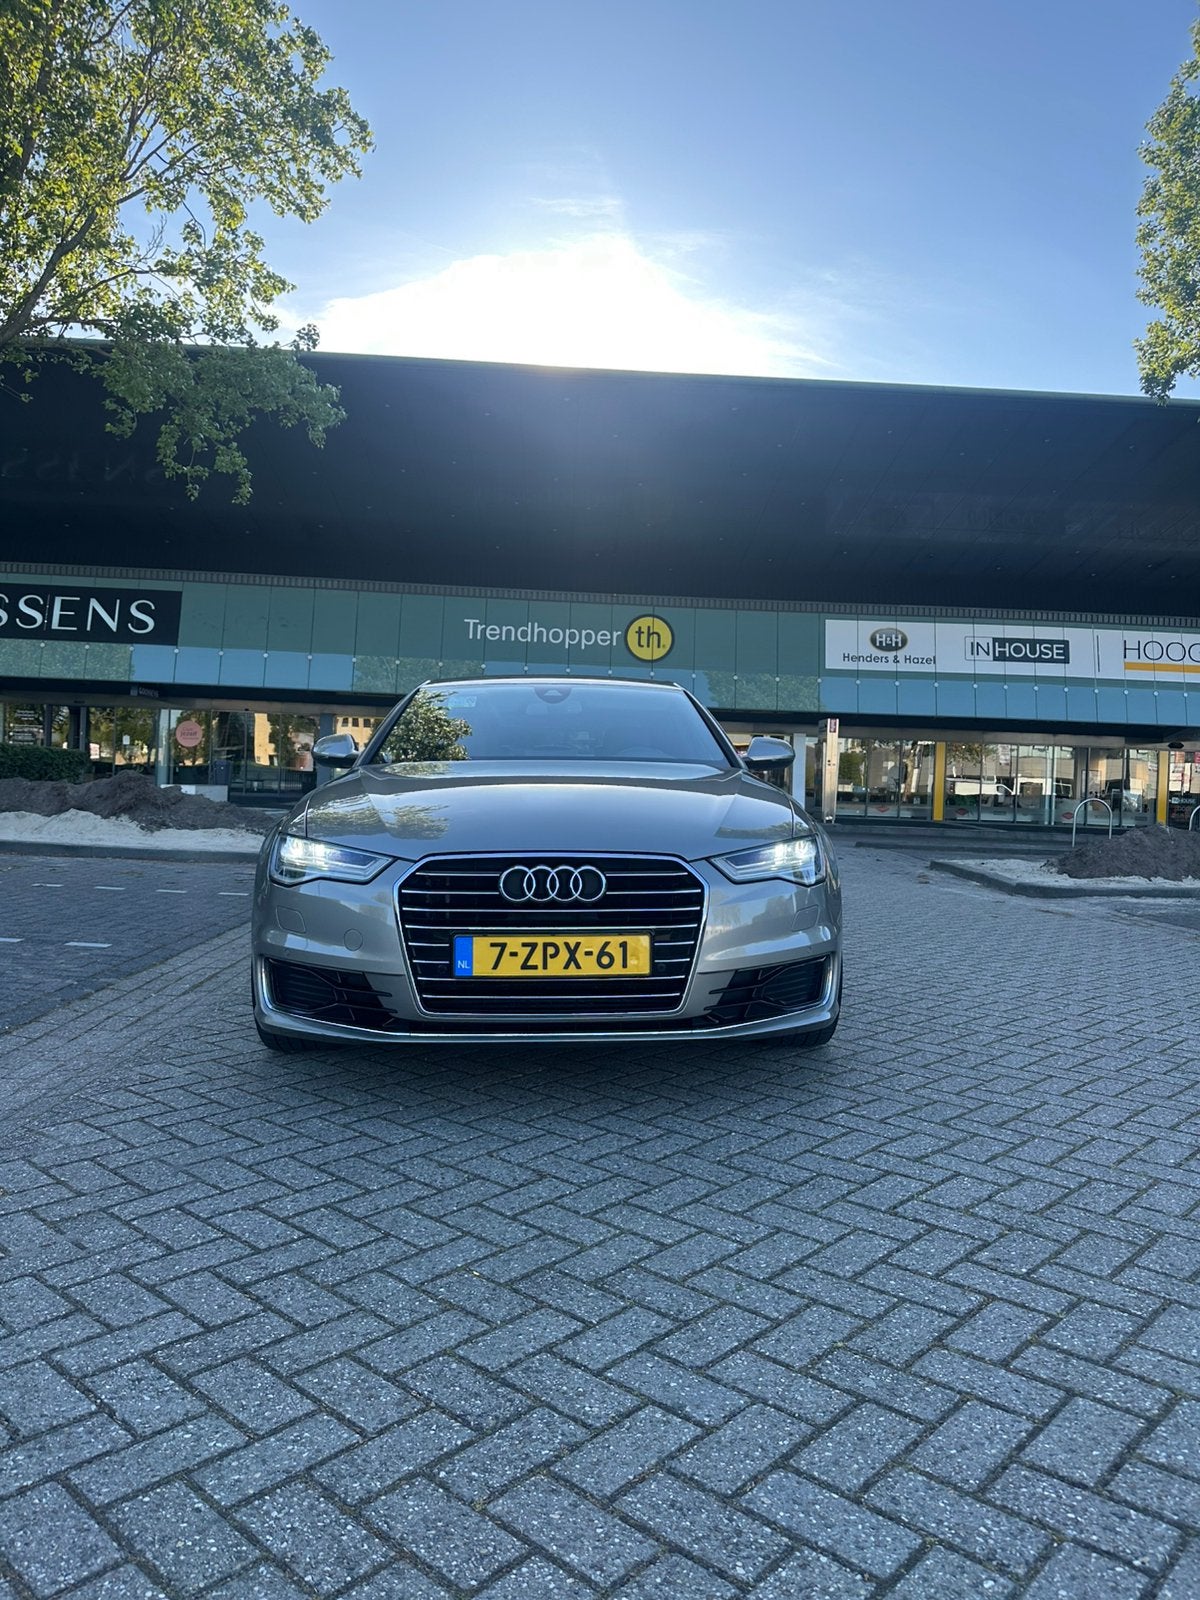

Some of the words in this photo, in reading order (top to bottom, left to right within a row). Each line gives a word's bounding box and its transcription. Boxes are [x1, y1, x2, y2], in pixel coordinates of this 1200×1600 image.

[463, 618, 621, 650] Trendhopper
[875, 633, 903, 647] H&H
[842, 652, 890, 664] Henders
[892, 654, 900, 664] &
[904, 655, 936, 665] Hazel
[489, 941, 628, 970] 7-ZPX-61
[457, 960, 470, 969] NL
